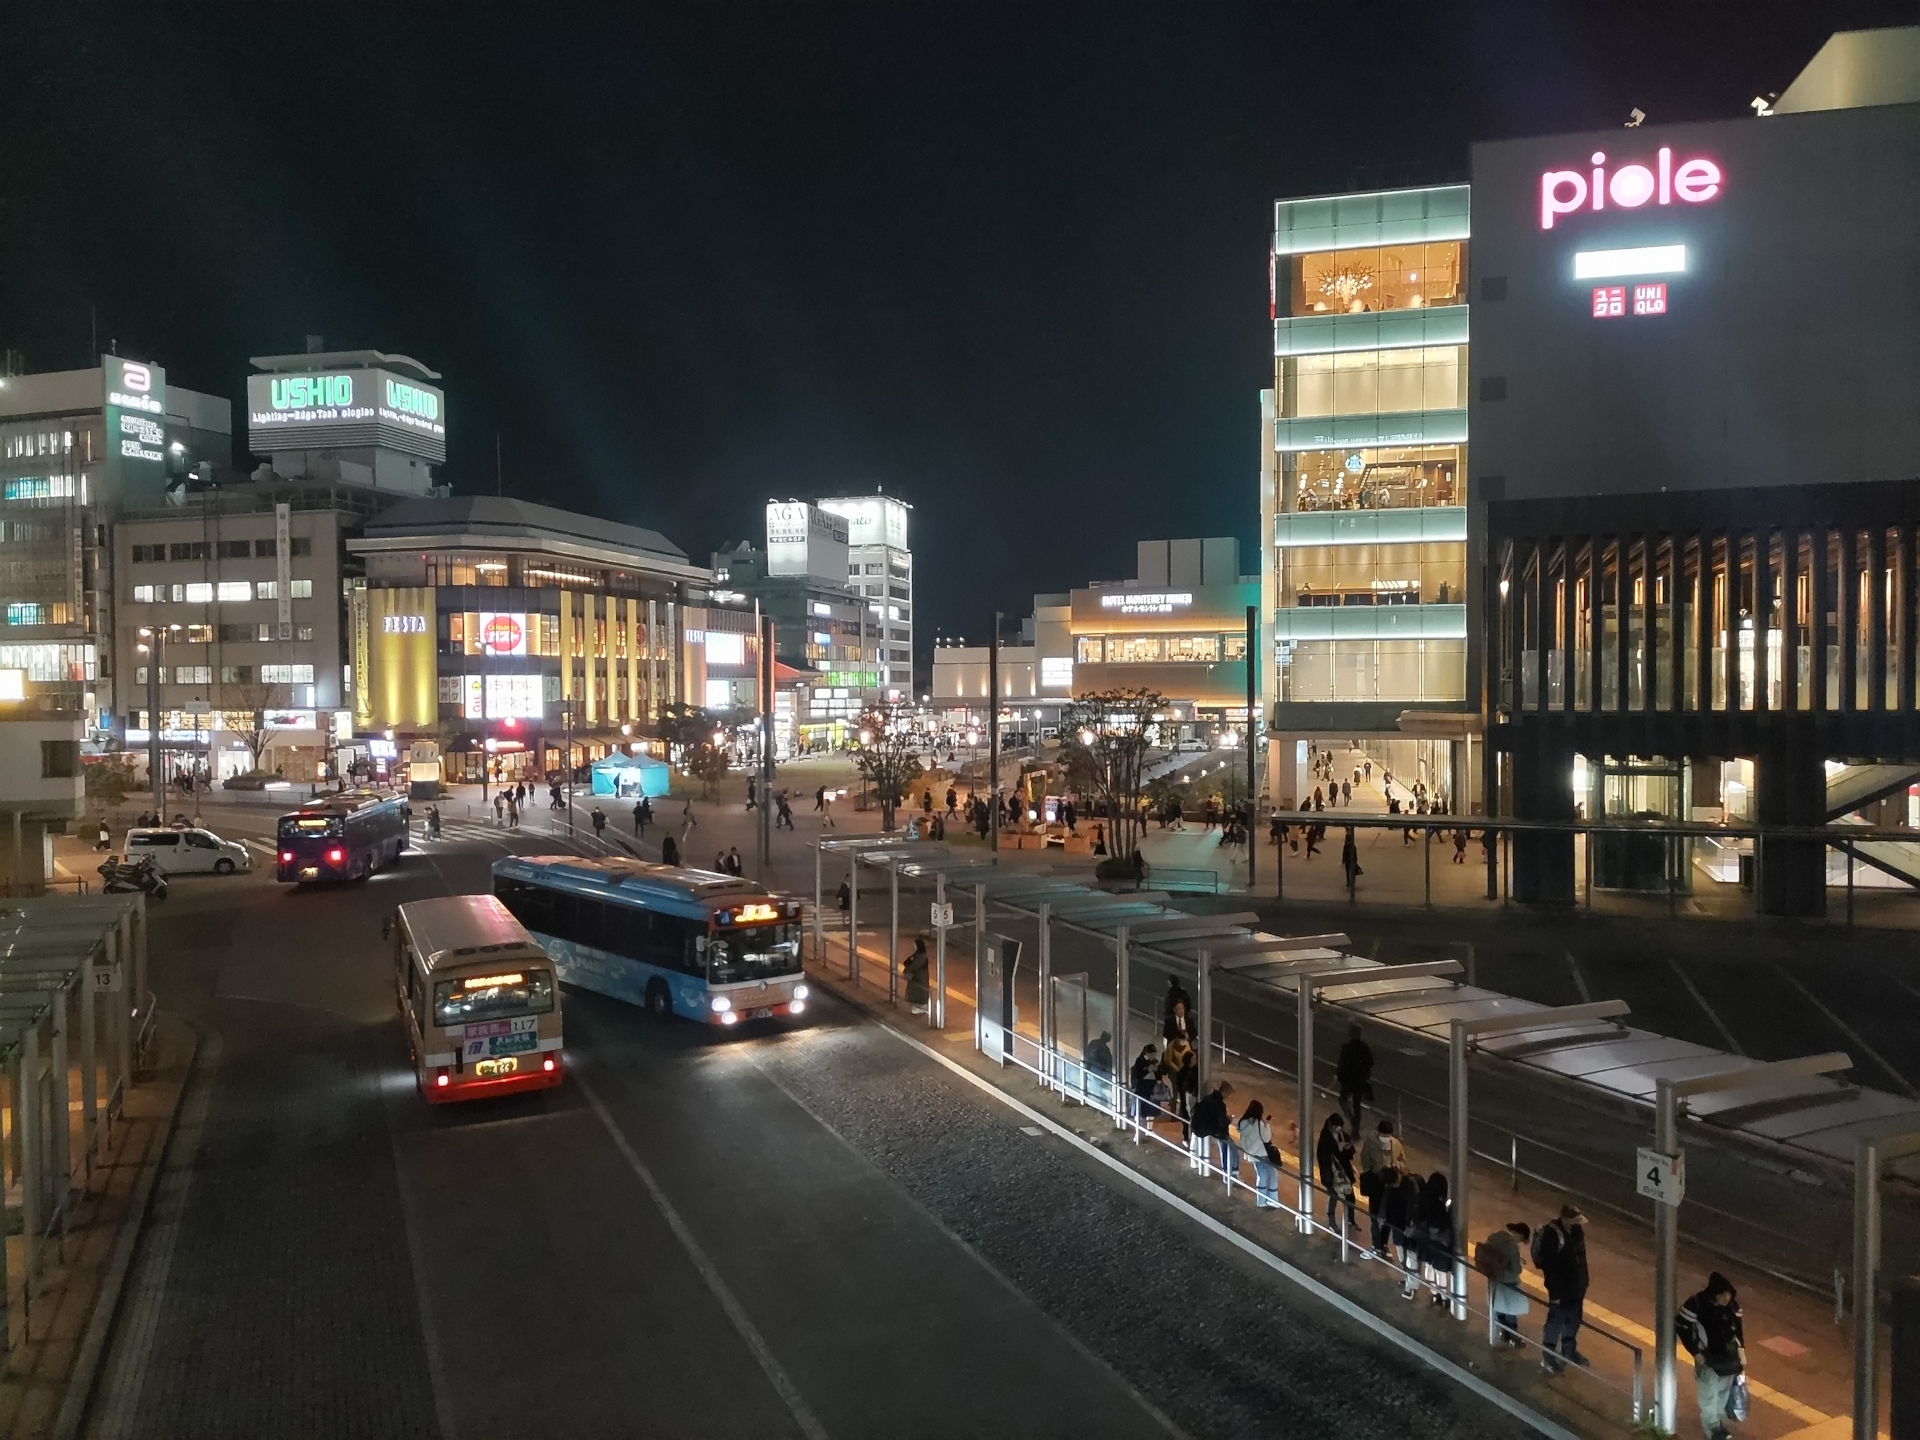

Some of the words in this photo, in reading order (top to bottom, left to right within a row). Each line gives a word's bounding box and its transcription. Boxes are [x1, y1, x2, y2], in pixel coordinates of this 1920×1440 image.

[1542, 147, 1720, 230] piole
[271, 375, 353, 409] USHIO
[386, 379, 438, 420] USHIO
[769, 507, 805, 520] AGA
[1102, 595, 1126, 607] HOTEL
[1126, 594, 1166, 605] MONTEREY
[383, 615, 427, 634] FESTA
[943, 909, 949, 920] 5
[95, 973, 111, 986] 13
[1646, 1166, 1662, 1187] 4
